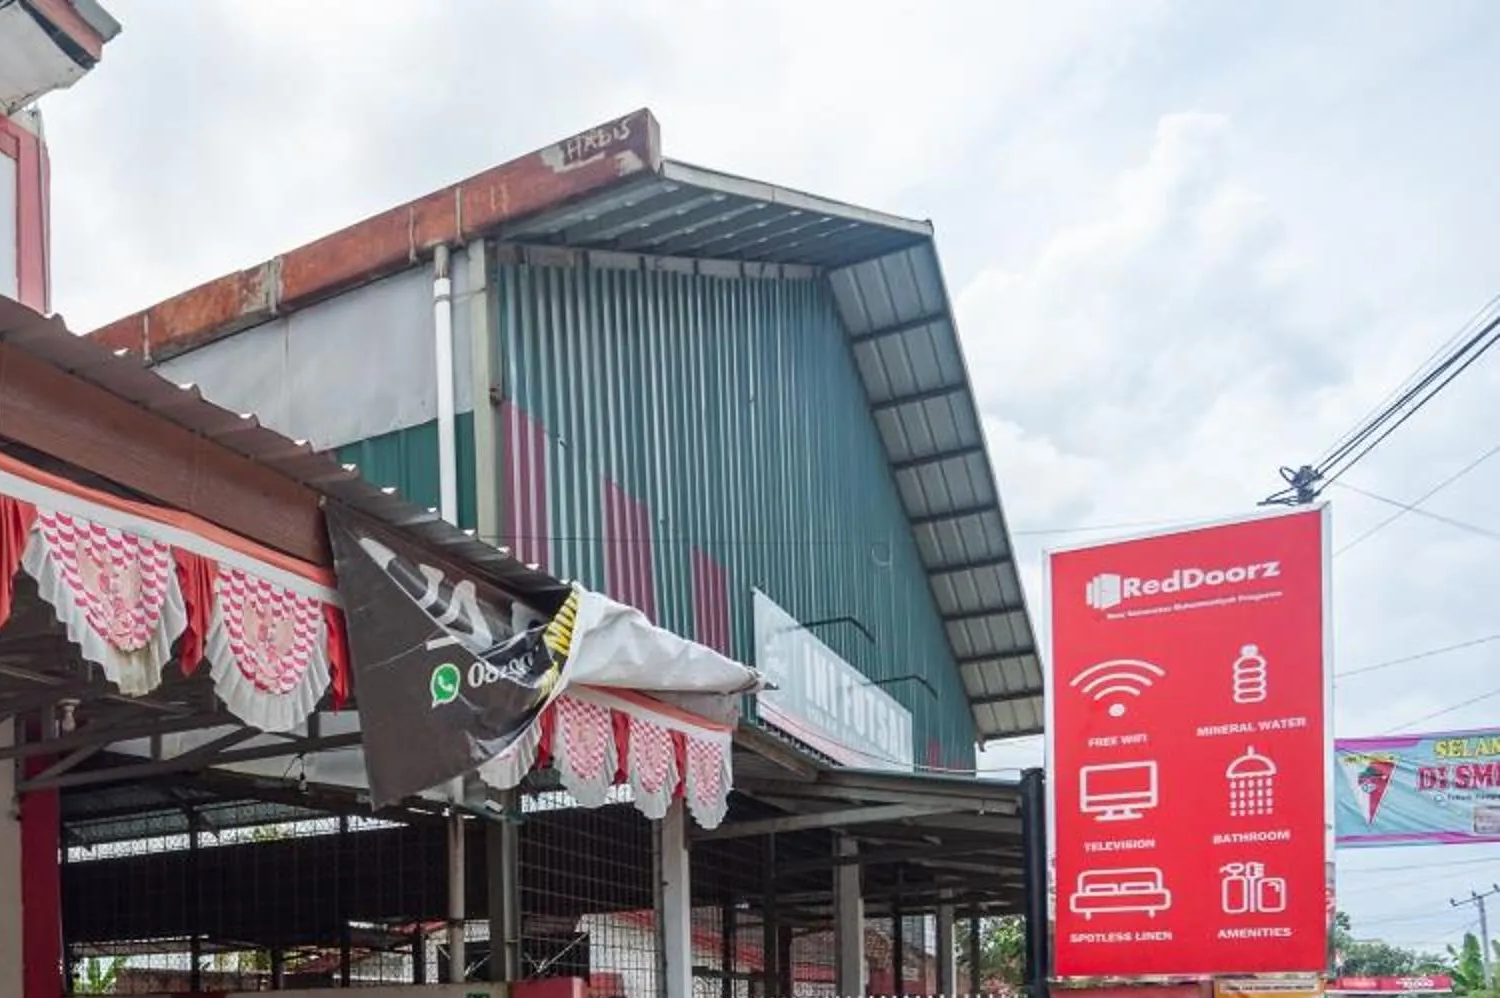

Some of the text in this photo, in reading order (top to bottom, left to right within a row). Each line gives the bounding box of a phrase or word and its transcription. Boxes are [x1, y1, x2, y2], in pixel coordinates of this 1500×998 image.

[1123, 560, 1281, 599] RedDoorz
[1196, 717, 1306, 736] MINERAL WATER
[1088, 736, 1117, 748] FREE
[1454, 761, 1500, 789] SM
[1212, 830, 1291, 845] BATHROOM
[1084, 839, 1156, 852] TELEVISION
[1069, 929, 1173, 943] SPOTLESS LINEN
[1217, 927, 1293, 940] AMENITIES
